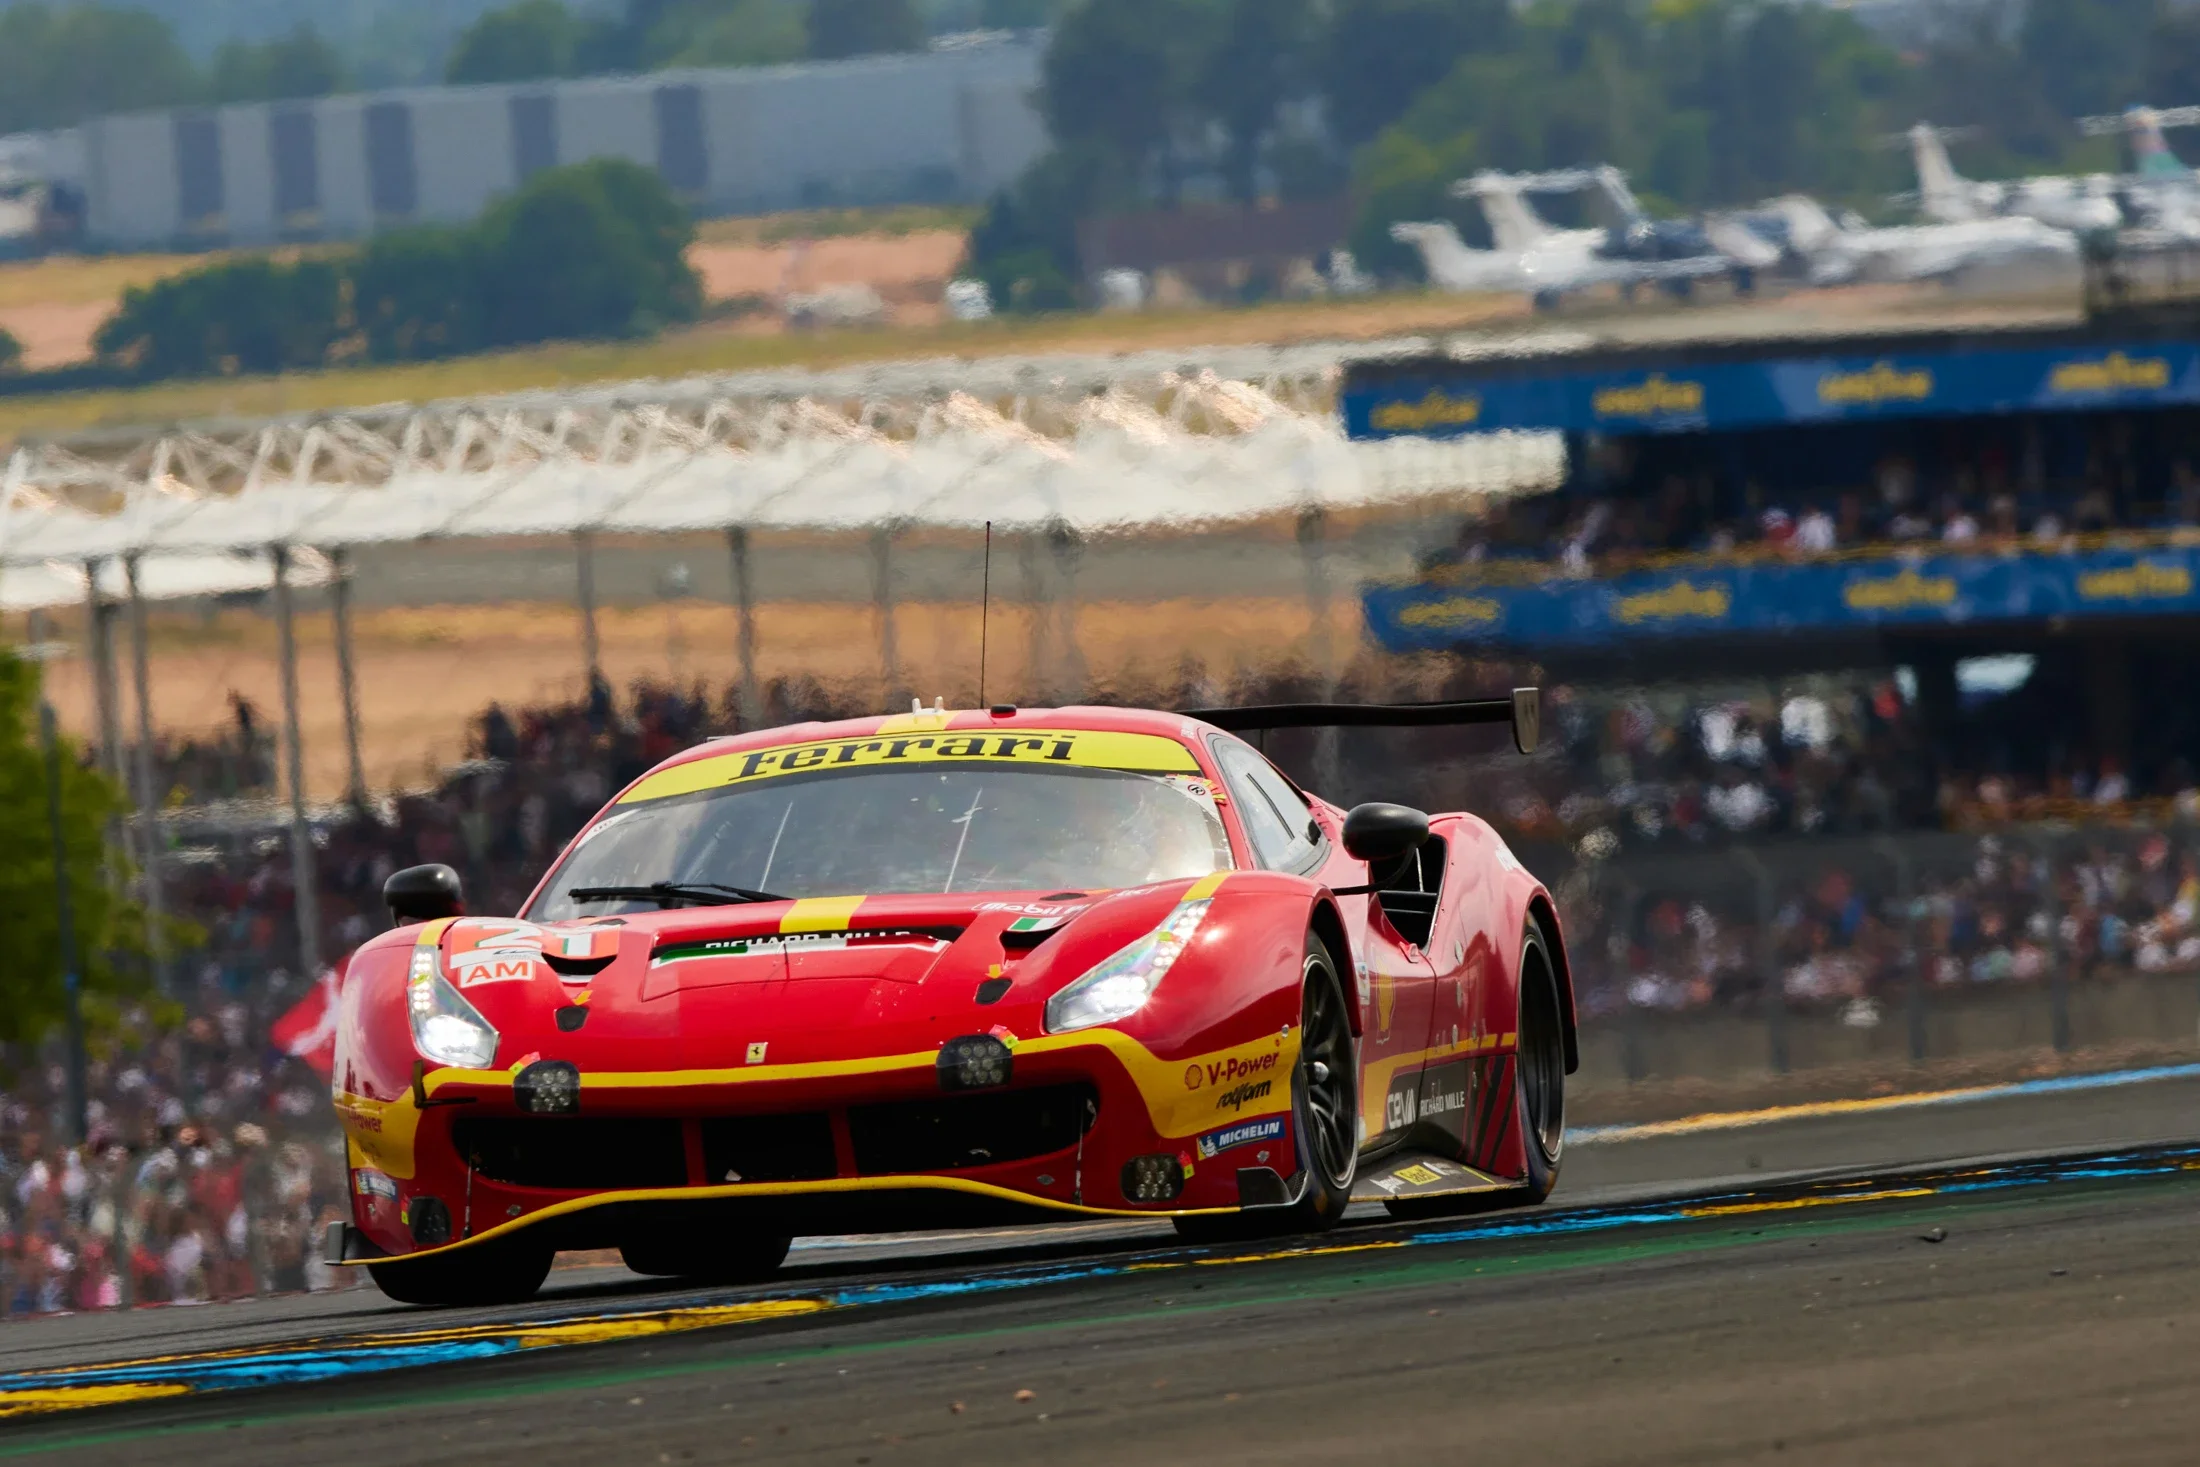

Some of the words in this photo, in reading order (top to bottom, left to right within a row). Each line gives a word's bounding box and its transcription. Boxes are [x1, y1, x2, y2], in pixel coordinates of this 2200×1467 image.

[727, 733, 1077, 781] Ferrari
[976, 902, 1060, 915] Mobil
[466, 962, 528, 984] AM
[1206, 1052, 1280, 1086] V-Power
[1387, 1088, 1416, 1130] CEVA
[1420, 1094, 1444, 1117] RICHARD
[1445, 1091, 1465, 1110] MILLE
[1219, 1121, 1281, 1147] MICHELIN
